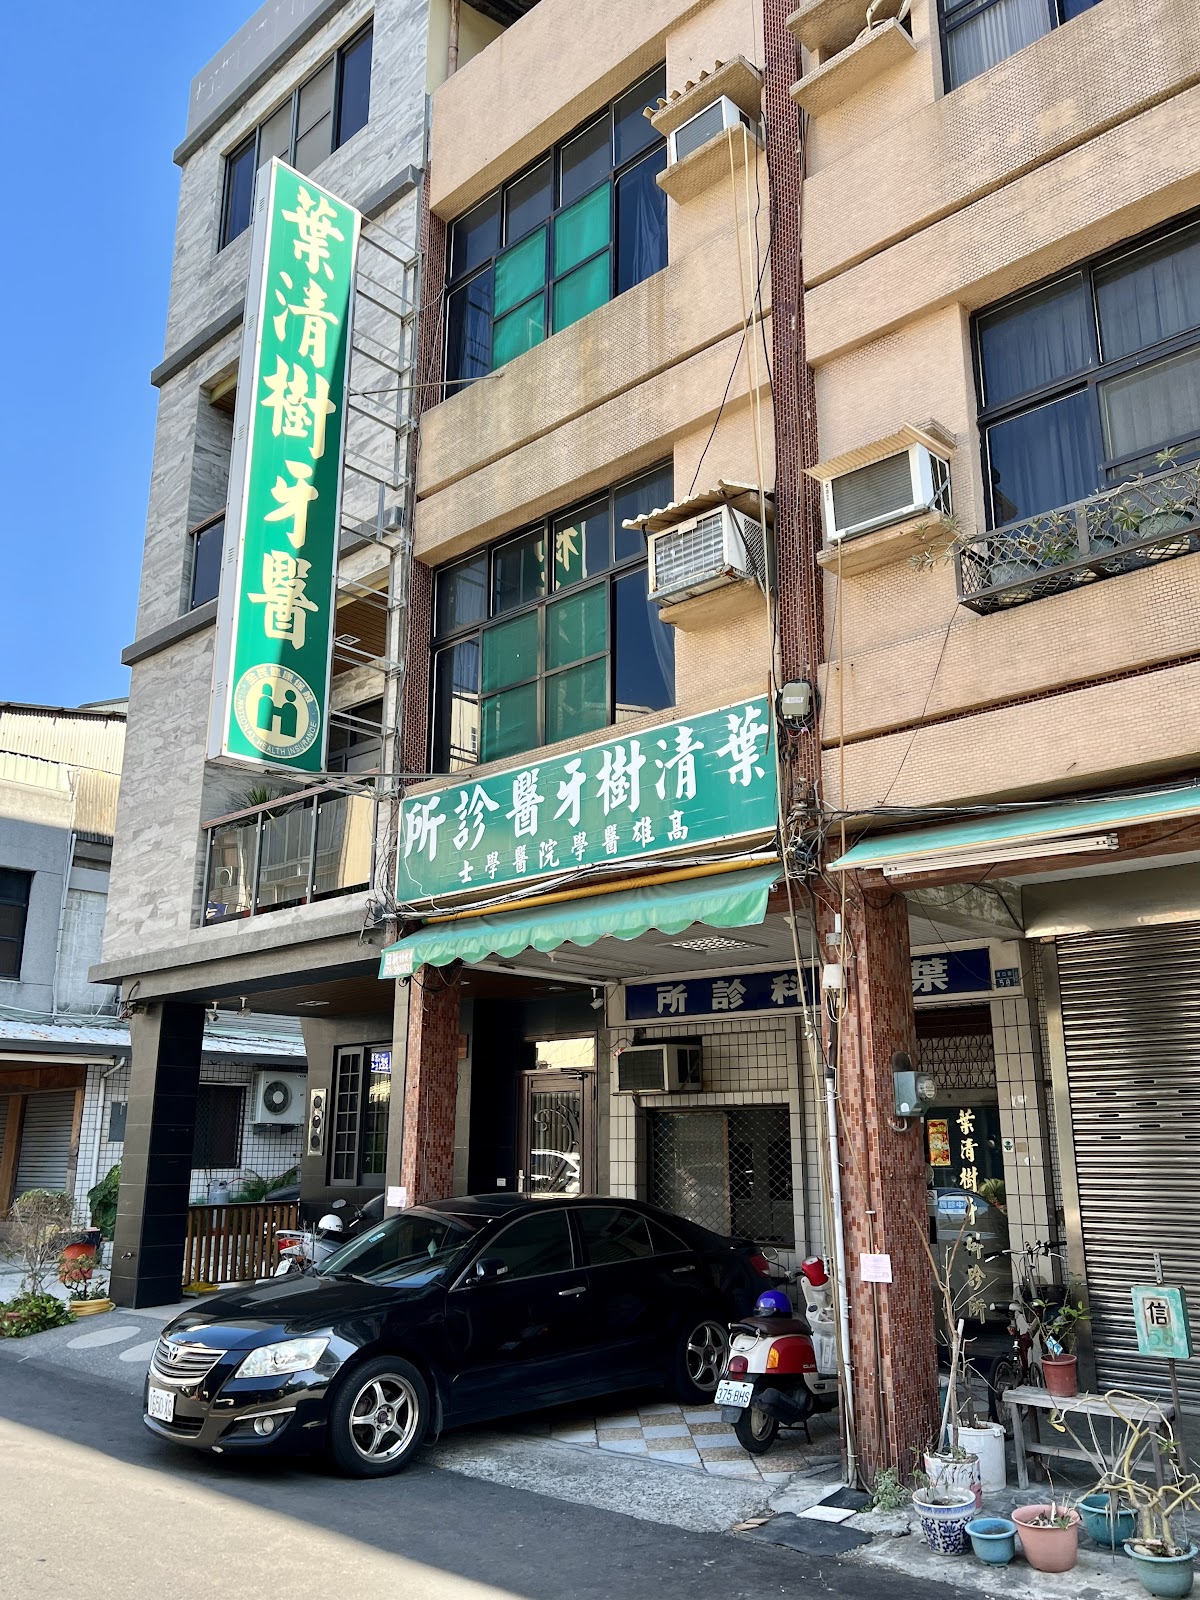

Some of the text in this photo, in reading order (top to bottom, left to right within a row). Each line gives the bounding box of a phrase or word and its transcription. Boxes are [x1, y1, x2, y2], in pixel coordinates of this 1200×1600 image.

[248, 186, 344, 650] 葉清樹牙醫
[256, 739, 286, 756] HEALTH
[404, 706, 769, 861] 葉清樹牙醫診所
[458, 809, 688, 883] 高雄醫學院醫學士
[1146, 1301, 1166, 1324] 信
[717, 1388, 750, 1403] 375-BHS
